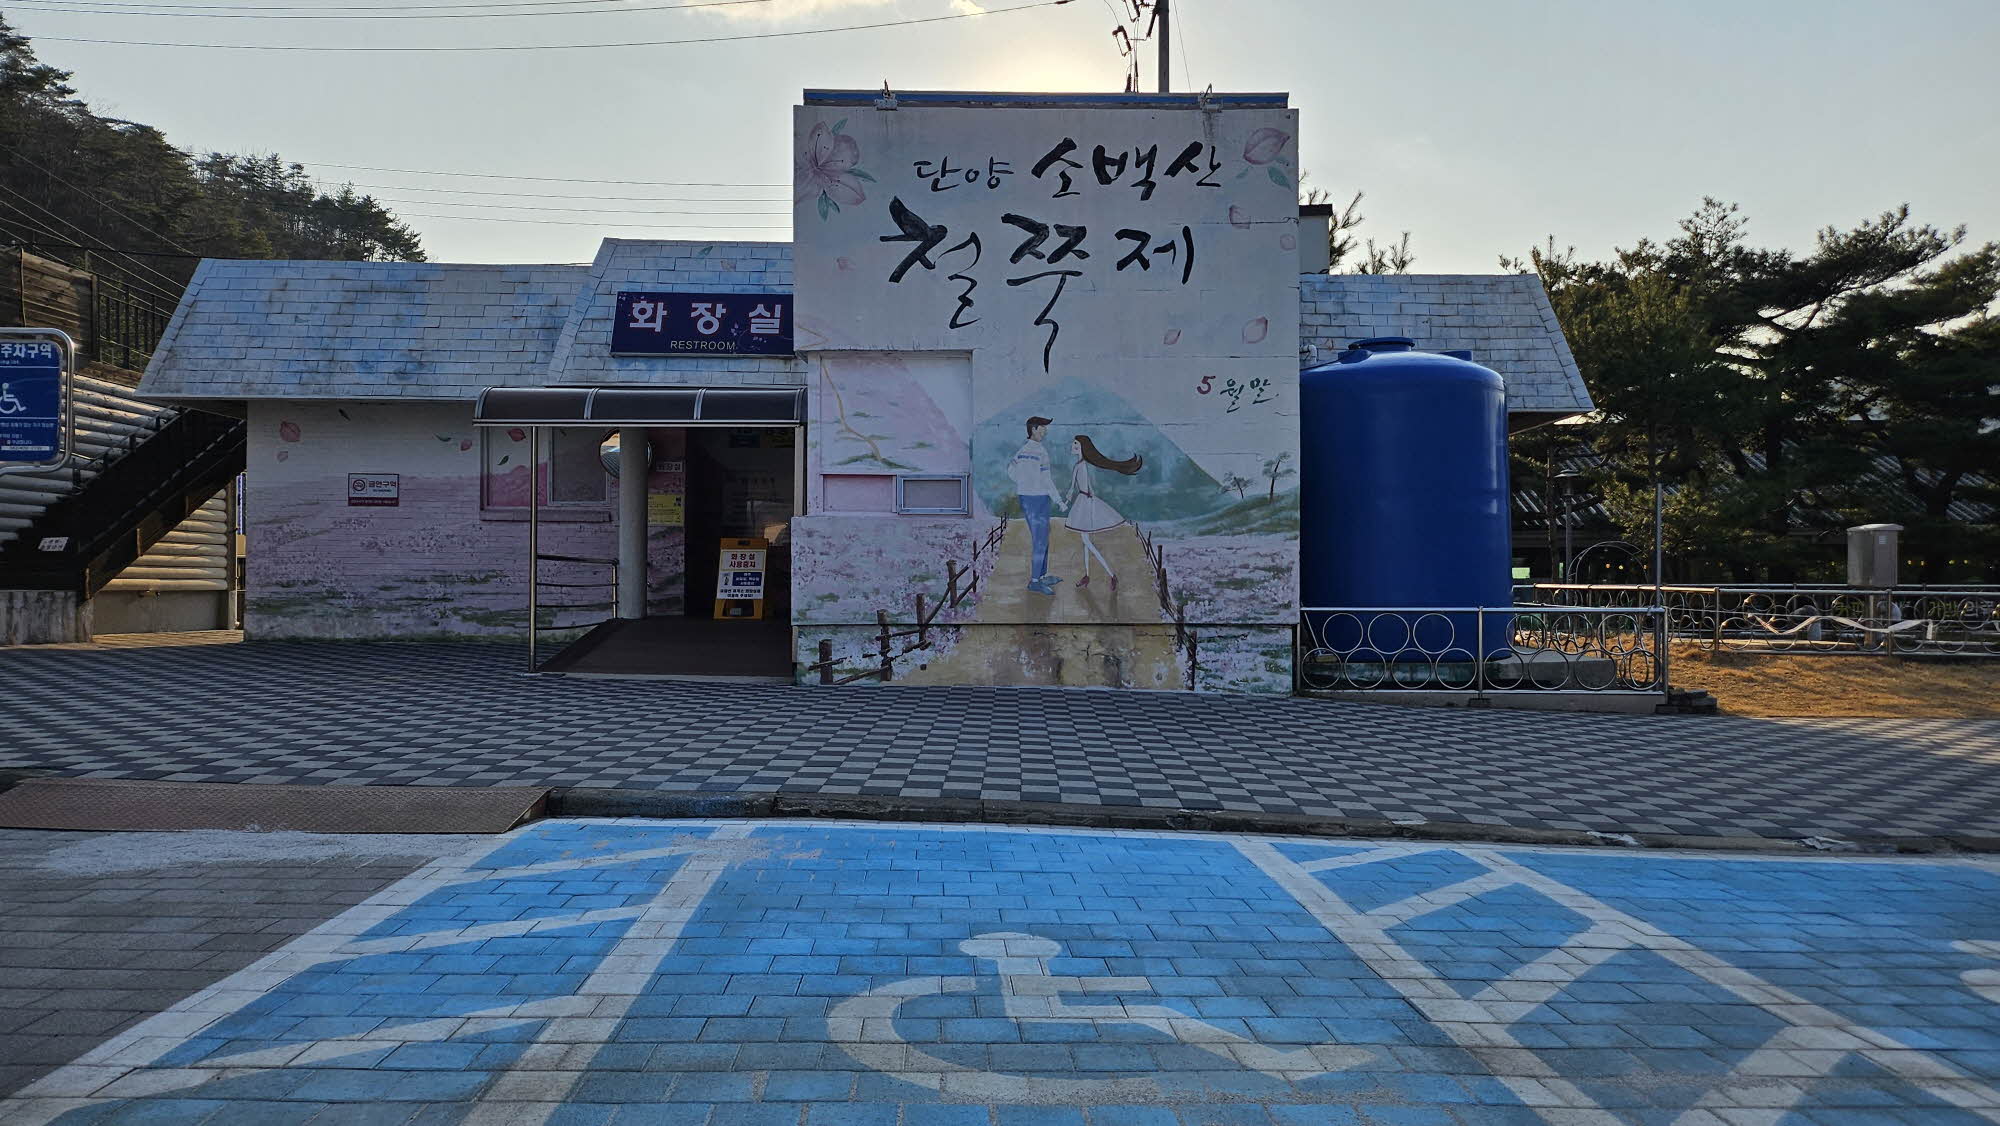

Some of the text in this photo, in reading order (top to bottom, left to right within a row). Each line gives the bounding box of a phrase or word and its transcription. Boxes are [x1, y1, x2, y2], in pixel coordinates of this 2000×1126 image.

[913, 136, 1222, 200] 단양 소백산
[879, 196, 1196, 374] 철쭉제
[629, 300, 782, 335] 화장실
[670, 340, 736, 350] RESTROOM
[368, 480, 397, 488] 금연구역
[729, 560, 756, 568] 사용중지
